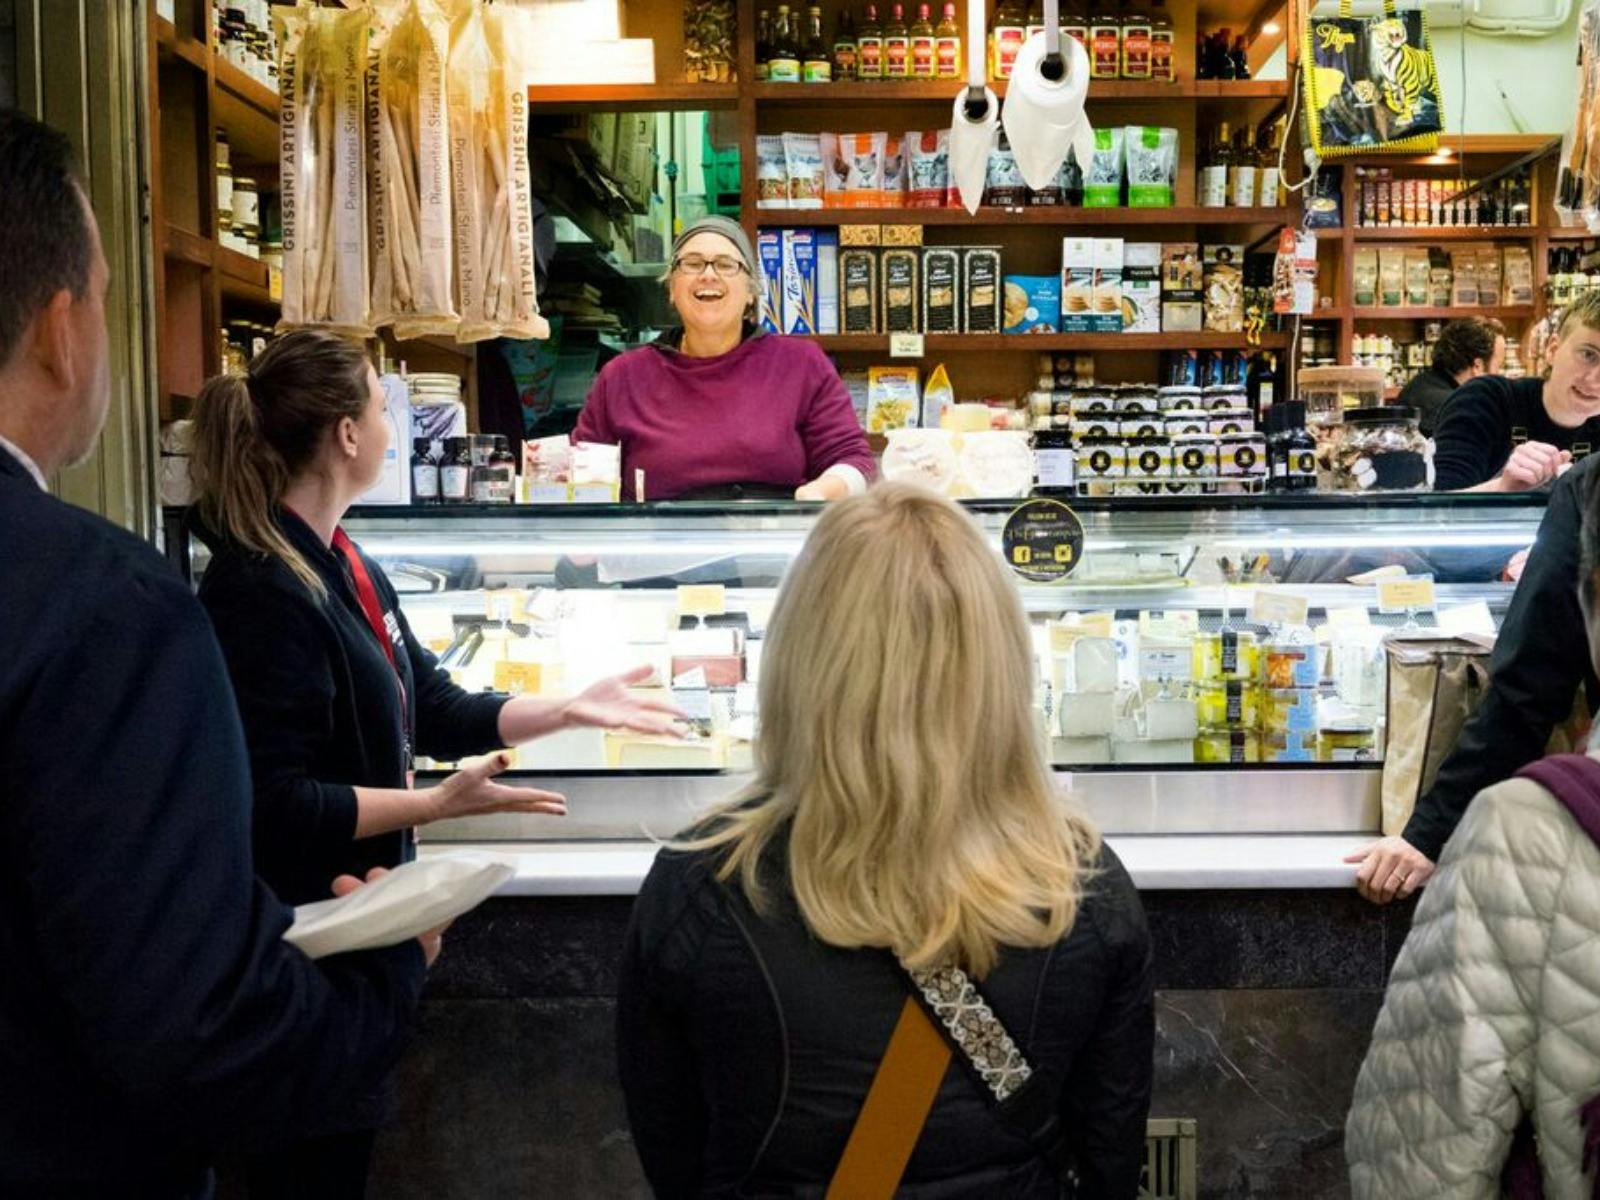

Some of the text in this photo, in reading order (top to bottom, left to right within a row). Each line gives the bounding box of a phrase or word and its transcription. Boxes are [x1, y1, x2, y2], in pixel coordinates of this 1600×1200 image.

[344, 95, 357, 134] Stirati
[283, 52, 296, 251] GRISSINI ARTIGIANALI
[344, 138, 357, 210] Piemontesi
[455, 138, 467, 211] Piemontesi
[512, 92, 533, 296] GRISSINI ARTIGIANALI
[459, 214, 471, 254] Stirati
[462, 269, 473, 306] Mano
